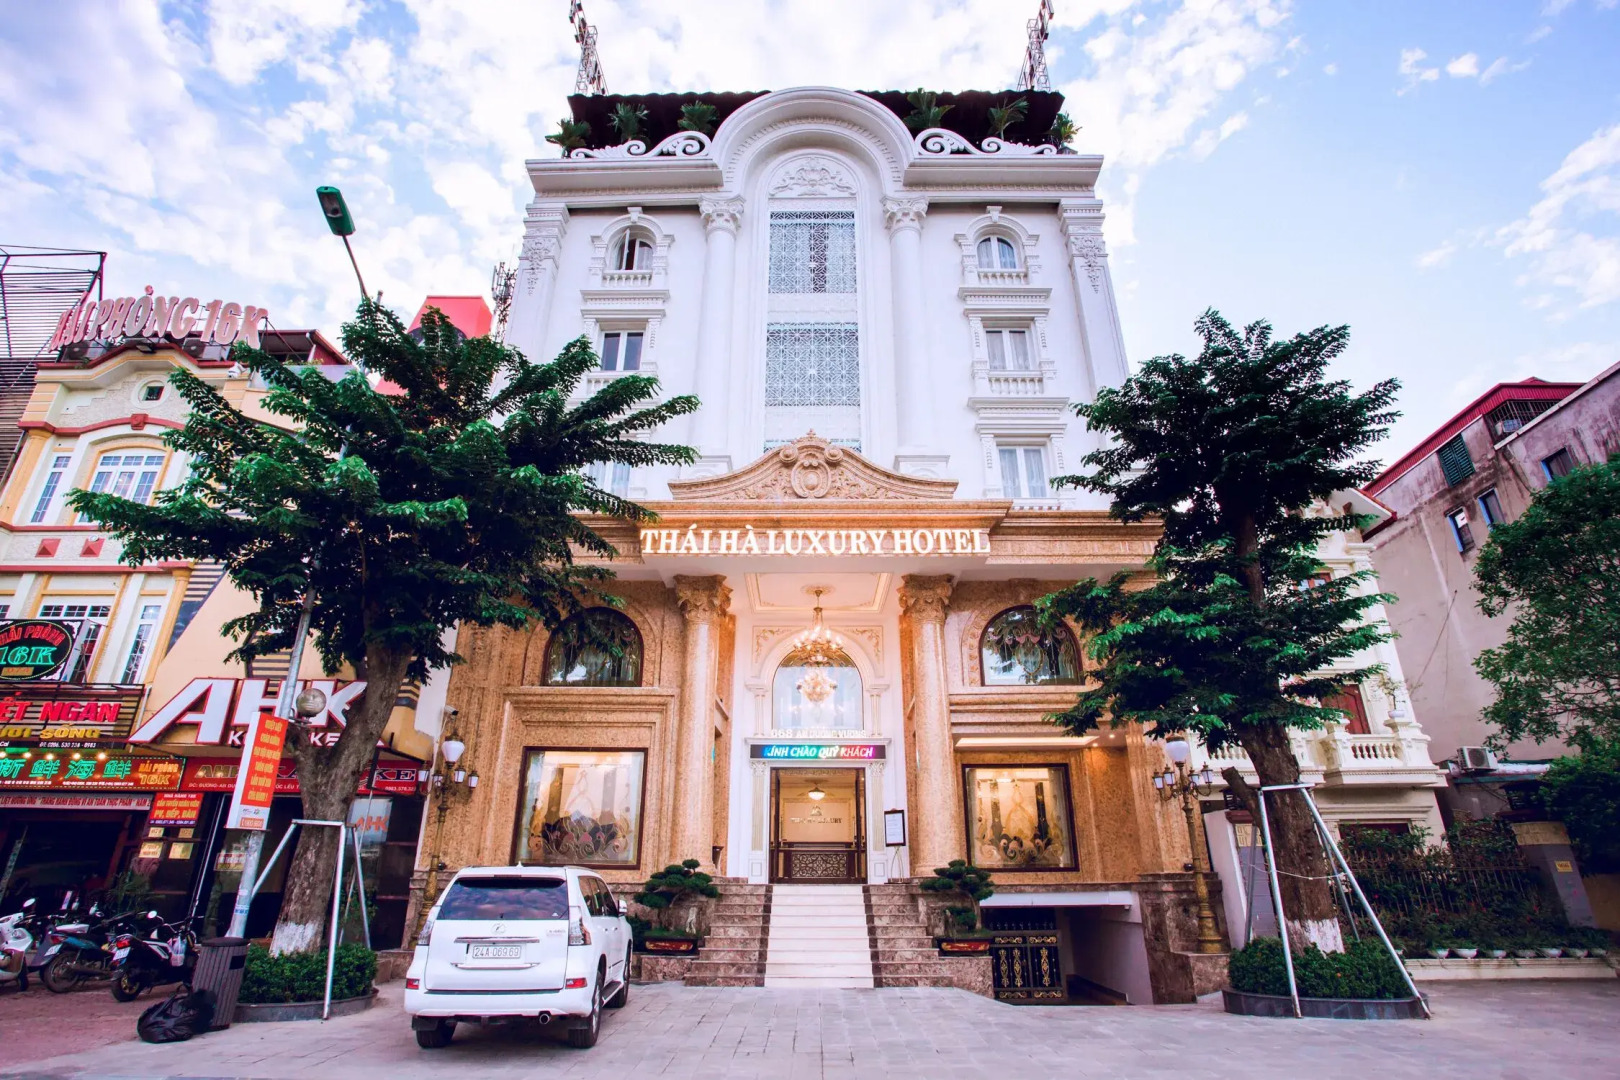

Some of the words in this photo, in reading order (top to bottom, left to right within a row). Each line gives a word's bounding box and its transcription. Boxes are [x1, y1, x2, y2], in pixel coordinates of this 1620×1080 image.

[200, 299, 268, 350] 16K
[640, 524, 714, 554] THÁI
[718, 524, 758, 554] HÀ
[766, 529, 893, 555] LUXURY
[893, 529, 991, 554] HOTEL
